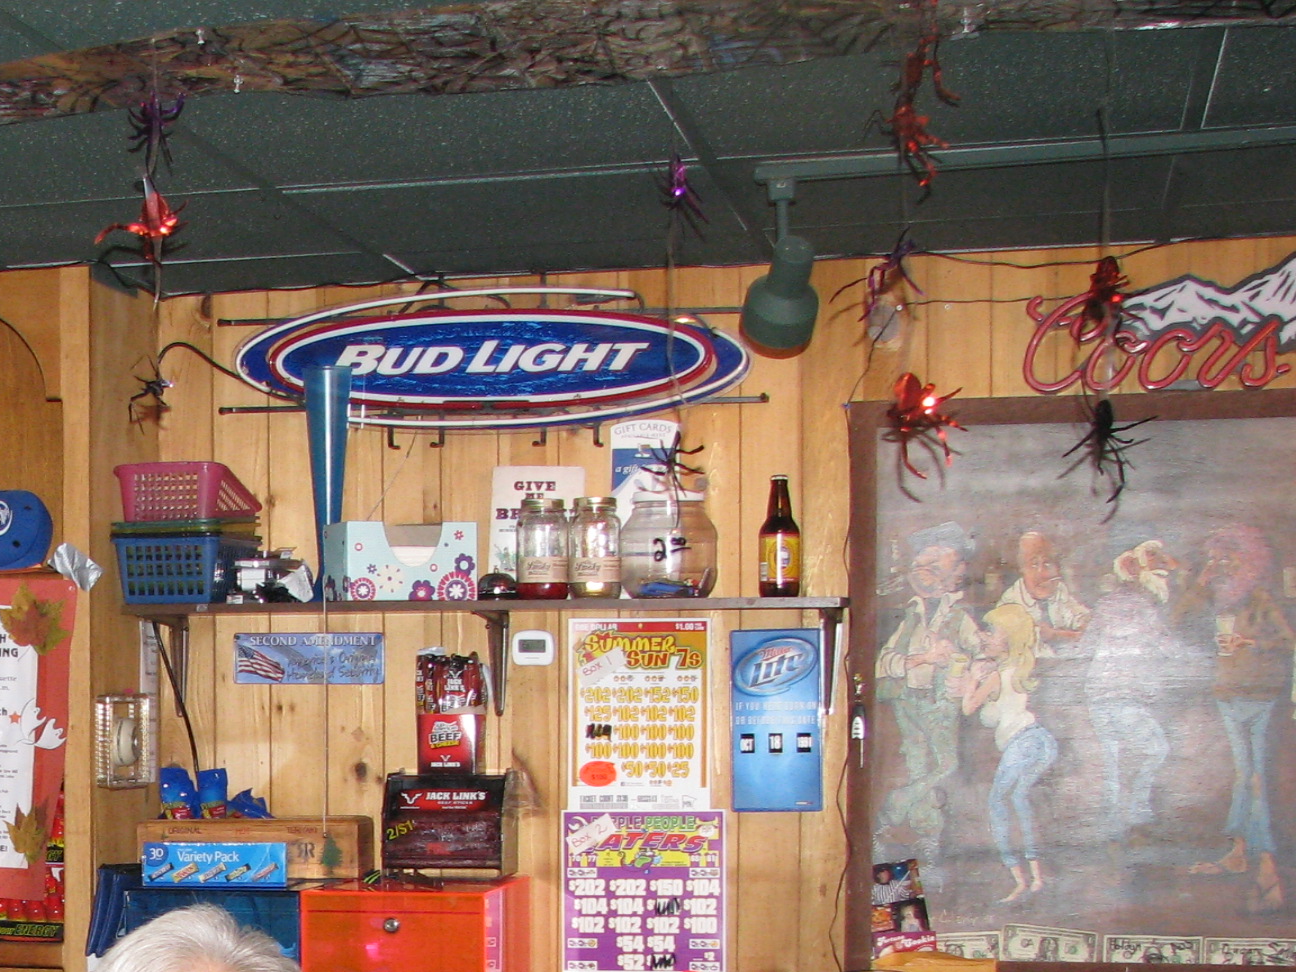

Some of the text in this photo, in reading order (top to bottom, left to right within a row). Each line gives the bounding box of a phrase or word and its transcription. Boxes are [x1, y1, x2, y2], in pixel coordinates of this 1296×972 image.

[1022, 291, 1292, 395] Coors
[335, 340, 650, 376] BUD LIGHT
[614, 422, 673, 436] GIFT CARDS
[514, 481, 556, 492] GIVE
[524, 492, 545, 500] ME
[250, 636, 376, 647] SECOND AMENDMENT
[584, 633, 677, 654] SUMMER
[624, 649, 670, 670] SUN
[749, 653, 804, 688] Lite
[430, 732, 461, 744] BEEF
[769, 735, 782, 750] 18
[425, 791, 486, 801] JACK LINK'S
[644, 816, 695, 830] PEOPLE
[592, 832, 708, 852] ATERS
[149, 847, 239, 864] 30 Variety Pack
[569, 879, 721, 897] $202 $202 $150 $104
[574, 898, 718, 915] $104 $104 $102
[616, 935, 676, 953] $54 $54
